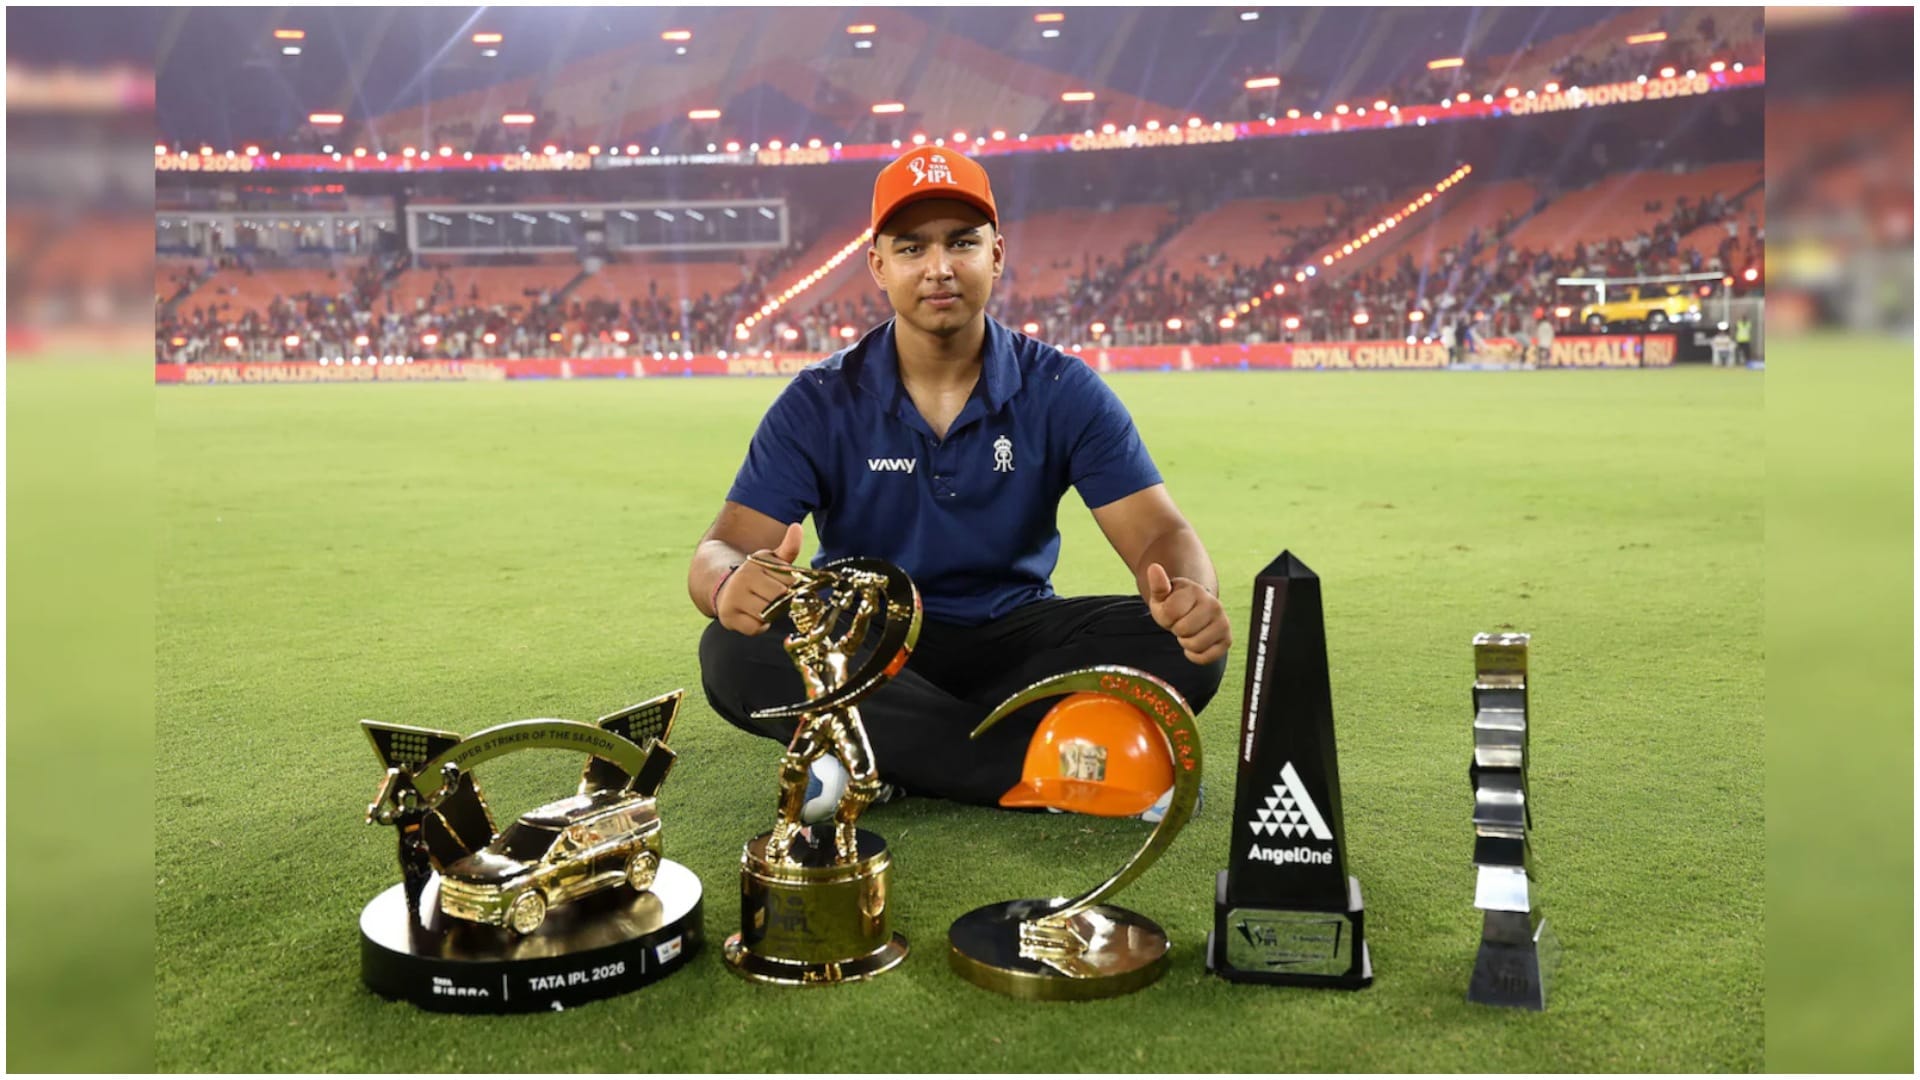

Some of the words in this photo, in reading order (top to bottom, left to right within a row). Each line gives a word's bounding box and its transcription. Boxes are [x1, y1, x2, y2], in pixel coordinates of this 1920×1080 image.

[1510, 83, 1643, 116] CHAMPIONS
[1646, 73, 1709, 100] 2026
[1071, 129, 1183, 151] CHAMPIONS
[1186, 124, 1236, 144] 2026
[504, 153, 591, 171] CHAMPIO
[927, 170, 958, 185] IPL
[1292, 348, 1352, 368] ROYAL
[185, 365, 240, 384] ROYAL
[1262, 585, 1274, 623] SEASON
[1260, 623, 1270, 641] THE
[1258, 641, 1267, 655] OF
[1250, 681, 1261, 712] SUPER
[1101, 675, 1181, 727] ORANGE
[1173, 729, 1196, 771] CAP
[1248, 712, 1257, 732] ONE
[452, 745, 482, 764] UPER
[484, 732, 529, 751] STRIKER
[531, 730, 546, 740] OF
[549, 730, 571, 740] THE
[572, 732, 615, 751] SEASON
[1244, 732, 1254, 762] ANGEL
[1248, 843, 1332, 865] AngelOne
[528, 974, 566, 992] TATA
[567, 971, 590, 986] IPL
[591, 960, 626, 982] 2026
[433, 986, 489, 997] SIERRA
